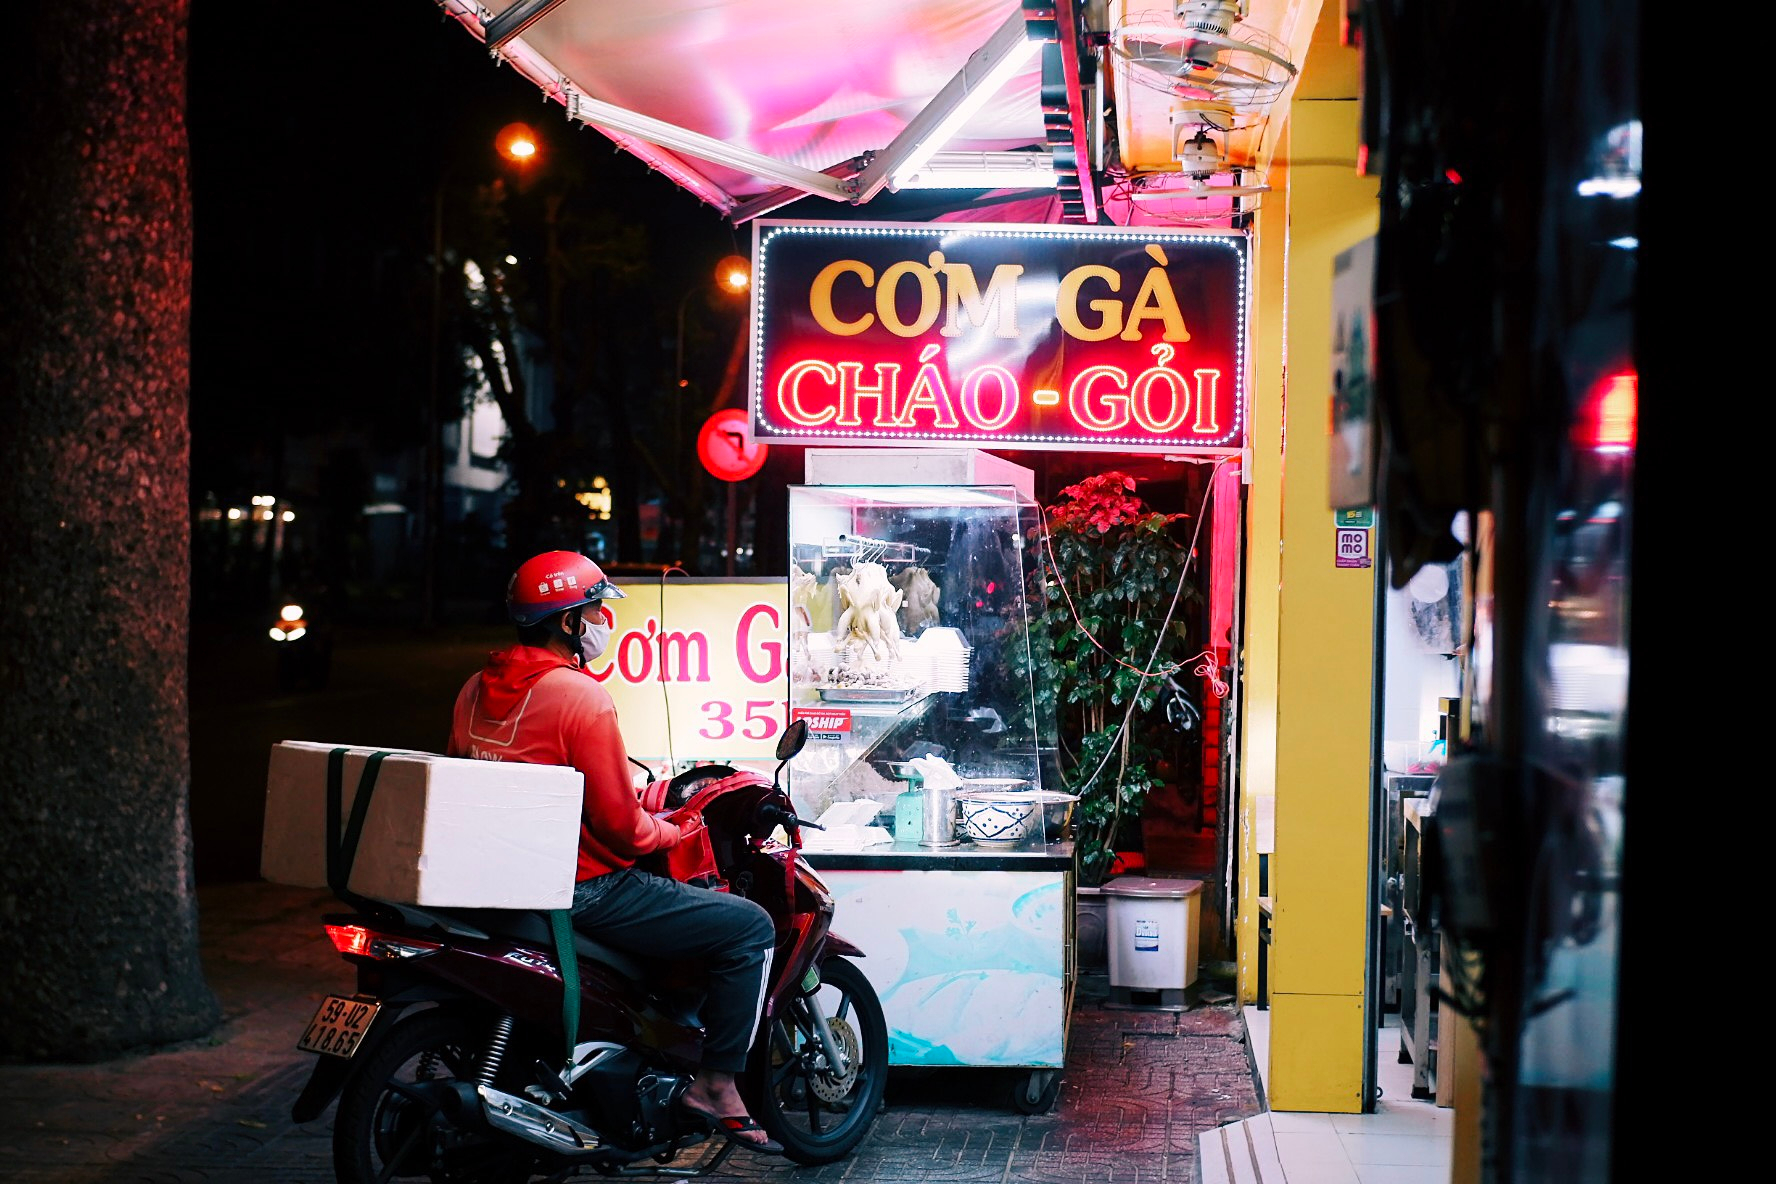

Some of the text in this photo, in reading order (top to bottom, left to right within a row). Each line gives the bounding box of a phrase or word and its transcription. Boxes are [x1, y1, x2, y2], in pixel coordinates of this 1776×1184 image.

[809, 243, 1191, 343] CƠM GÀ
[777, 343, 1020, 431] CHÁO
[1069, 342, 1221, 434] GỎI
[736, 603, 788, 684] G
[321, 999, 369, 1029] 59-U2
